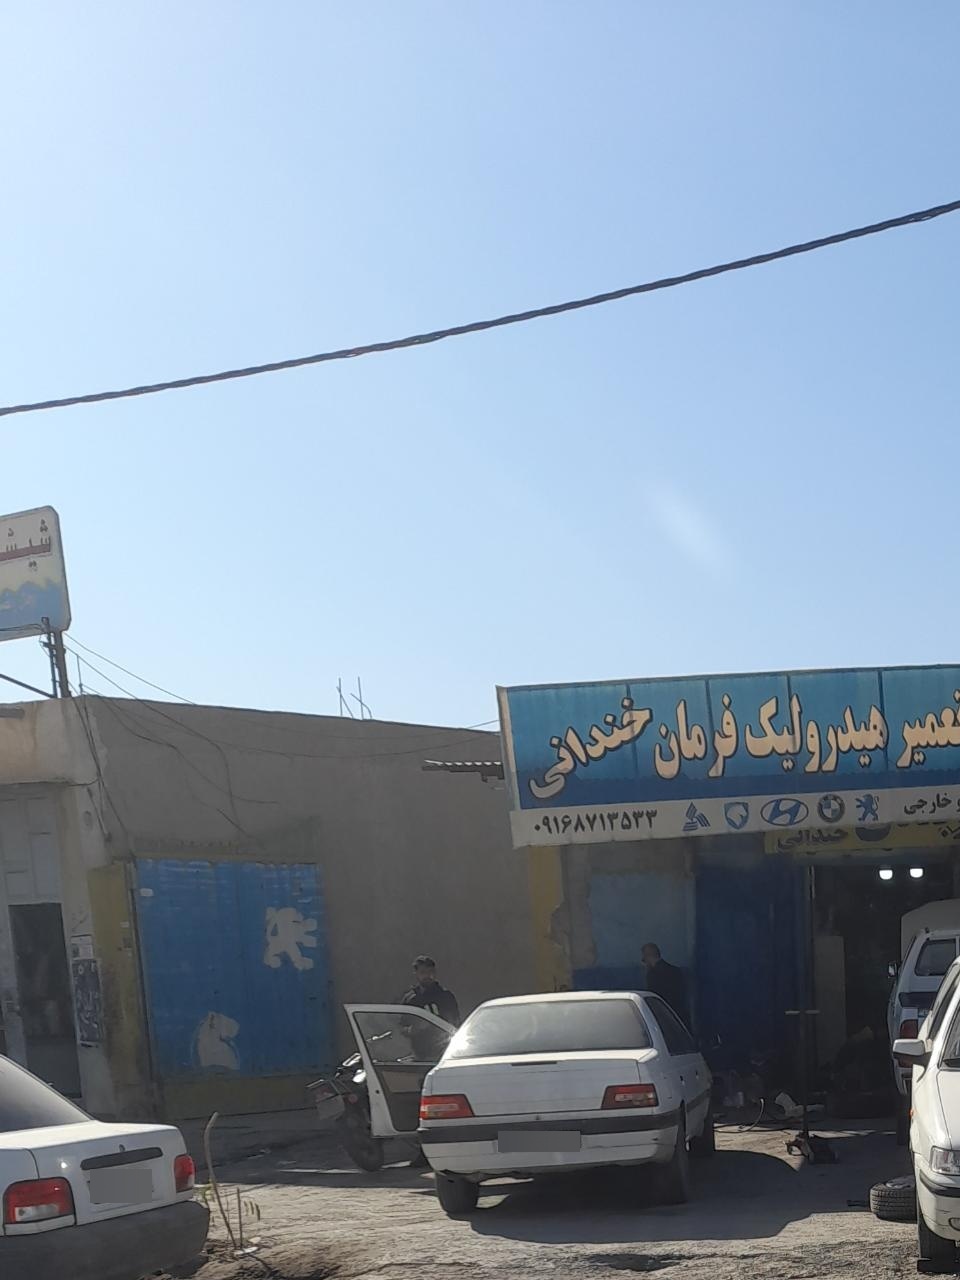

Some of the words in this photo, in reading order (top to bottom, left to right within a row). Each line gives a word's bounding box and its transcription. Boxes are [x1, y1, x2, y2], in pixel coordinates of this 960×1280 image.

[529, 697, 653, 799] خندانی
[654, 693, 738, 780] فرمان
[744, 693, 888, 773] هیدرولیک
[533, 809, 658, 835] ۰۹۱۶۸۷۱۳۵۳۳
[903, 792, 952, 815] خارجی
